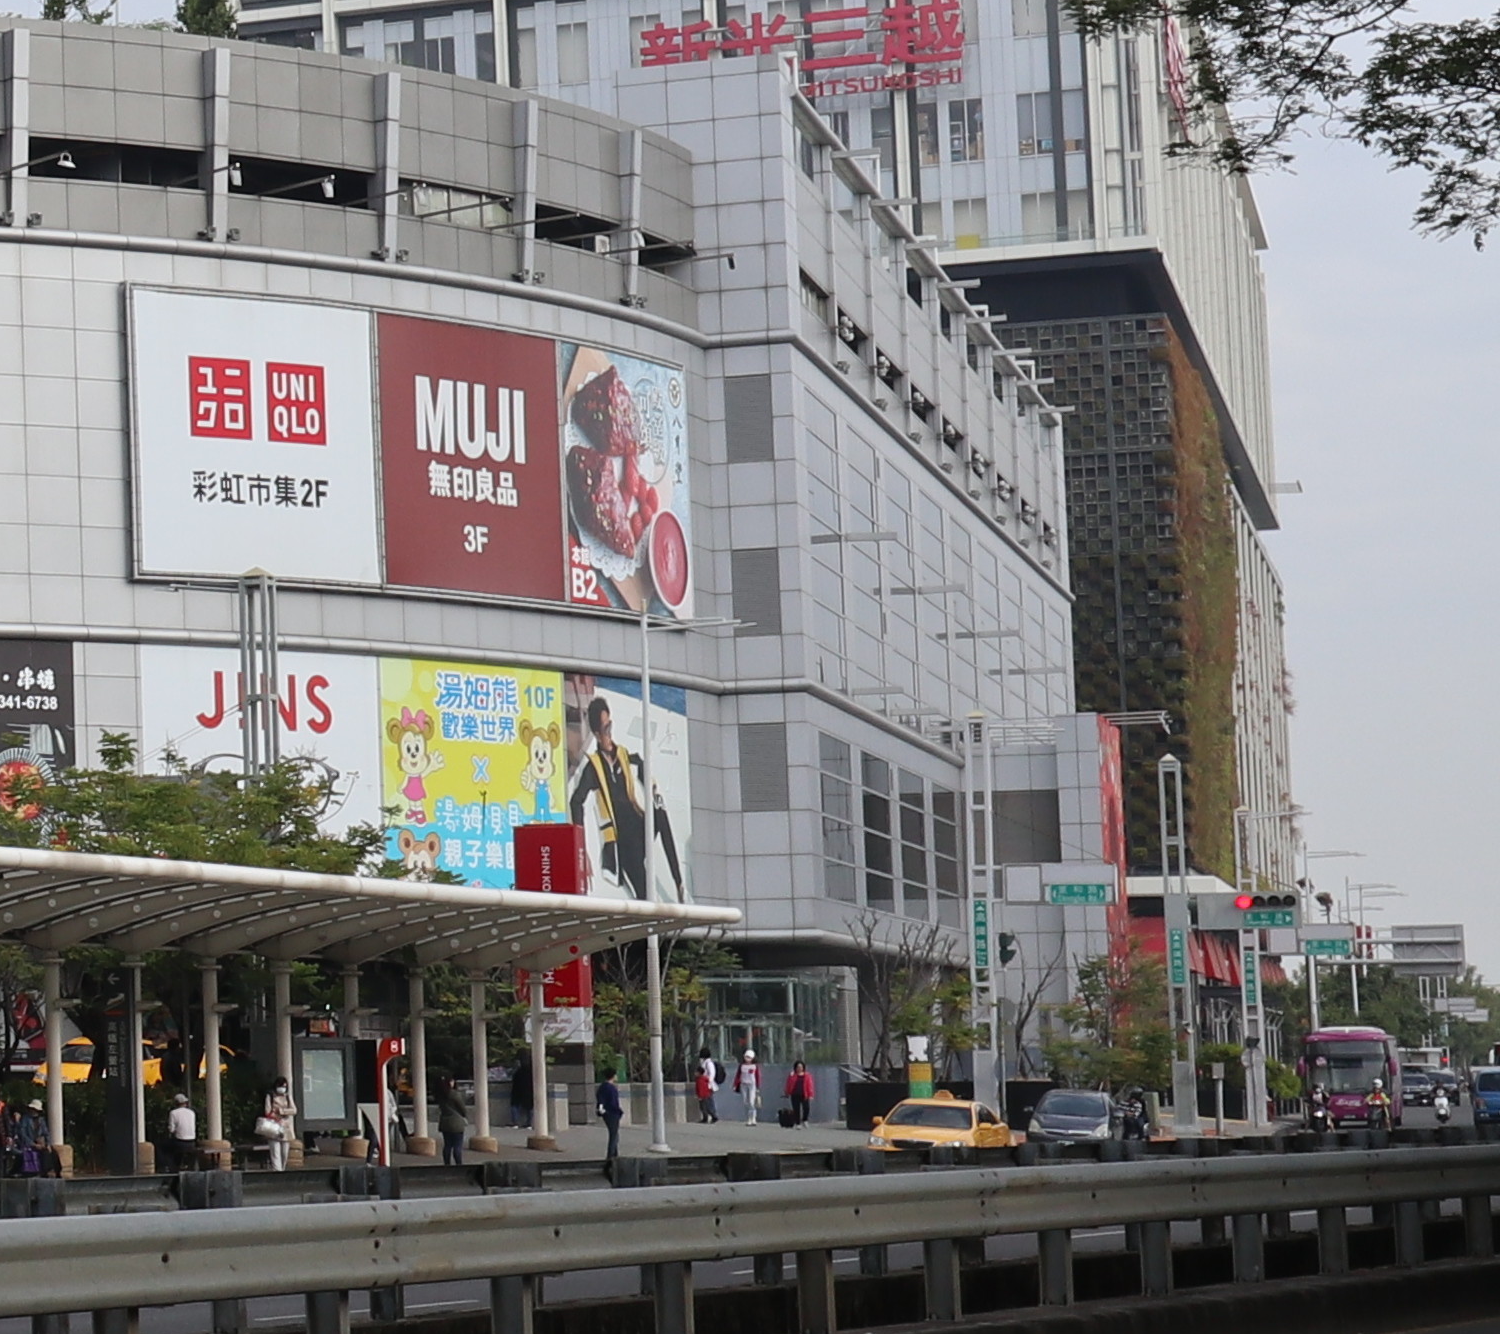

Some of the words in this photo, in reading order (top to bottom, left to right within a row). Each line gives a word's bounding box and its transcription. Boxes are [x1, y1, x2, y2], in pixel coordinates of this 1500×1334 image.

[272, 372, 315, 402] UNI
[273, 405, 320, 438] QLO
[415, 375, 526, 464] MUJI
[428, 460, 518, 507] 無印良品
[463, 524, 489, 553] 3F
[572, 567, 598, 600] B2
[435, 671, 519, 714] 湯姆熊
[524, 685, 555, 709] 10F
[441, 711, 516, 743] 歡樂世界
[541, 846, 551, 874] SHIN
[542, 876, 552, 891] KO
[390, 1040, 399, 1053] 8
